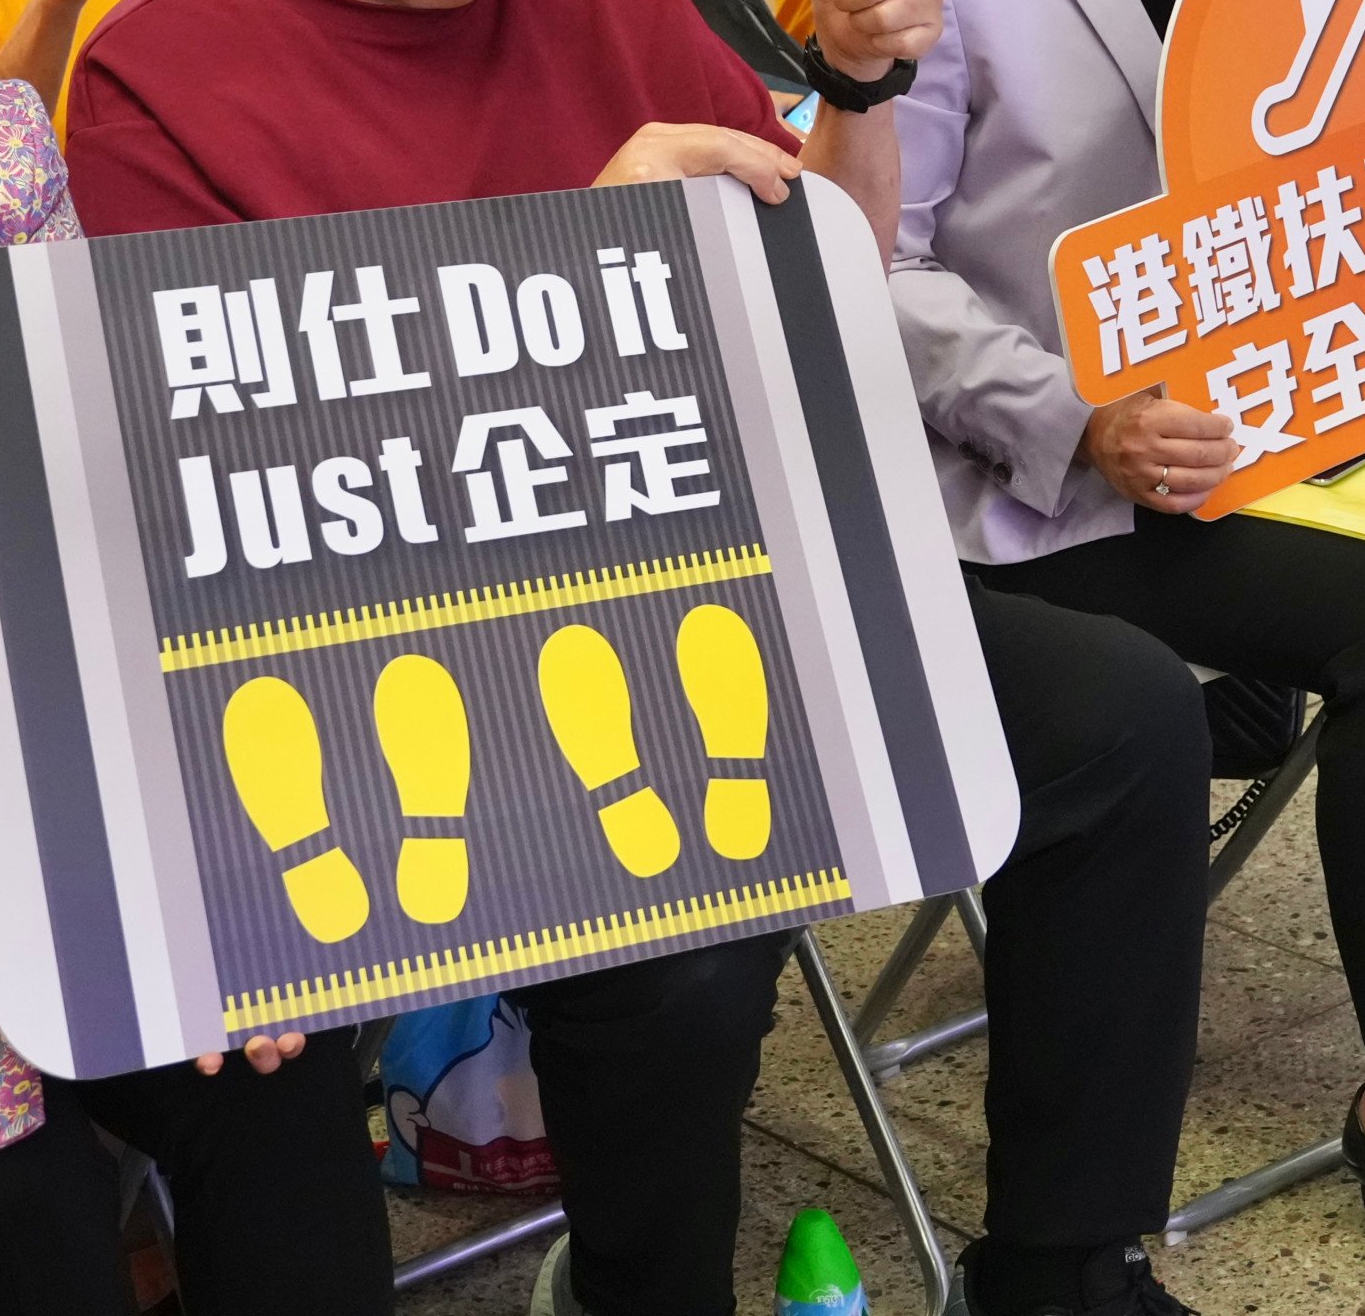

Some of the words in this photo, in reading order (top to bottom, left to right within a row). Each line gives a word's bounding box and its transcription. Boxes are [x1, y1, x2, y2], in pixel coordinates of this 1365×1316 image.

[153, 266, 431, 420] 則仕
[437, 262, 586, 378] Do
[597, 246, 689, 357] it
[179, 436, 439, 579] Just
[452, 390, 722, 544] 企定
